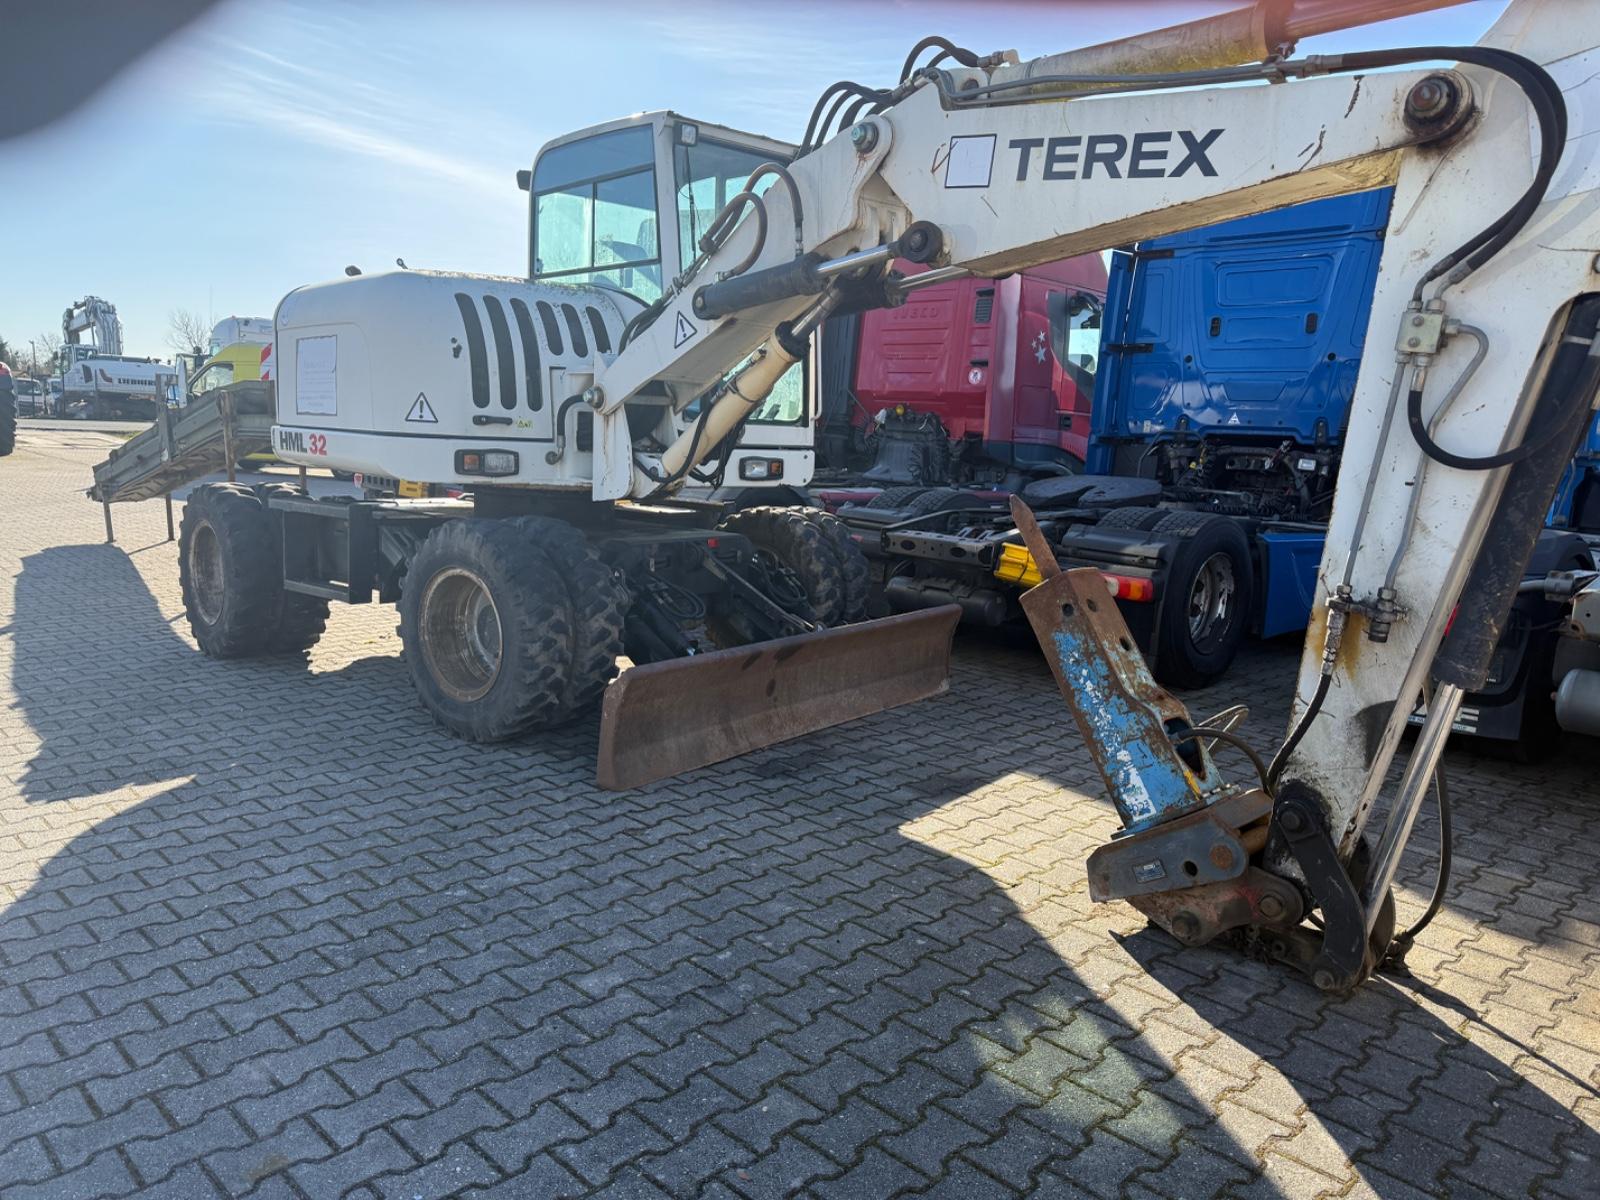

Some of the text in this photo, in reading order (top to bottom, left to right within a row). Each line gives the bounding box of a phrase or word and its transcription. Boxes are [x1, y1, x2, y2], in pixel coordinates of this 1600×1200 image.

[1008, 128, 1226, 181] TEREX
[279, 430, 328, 456] HML 32
